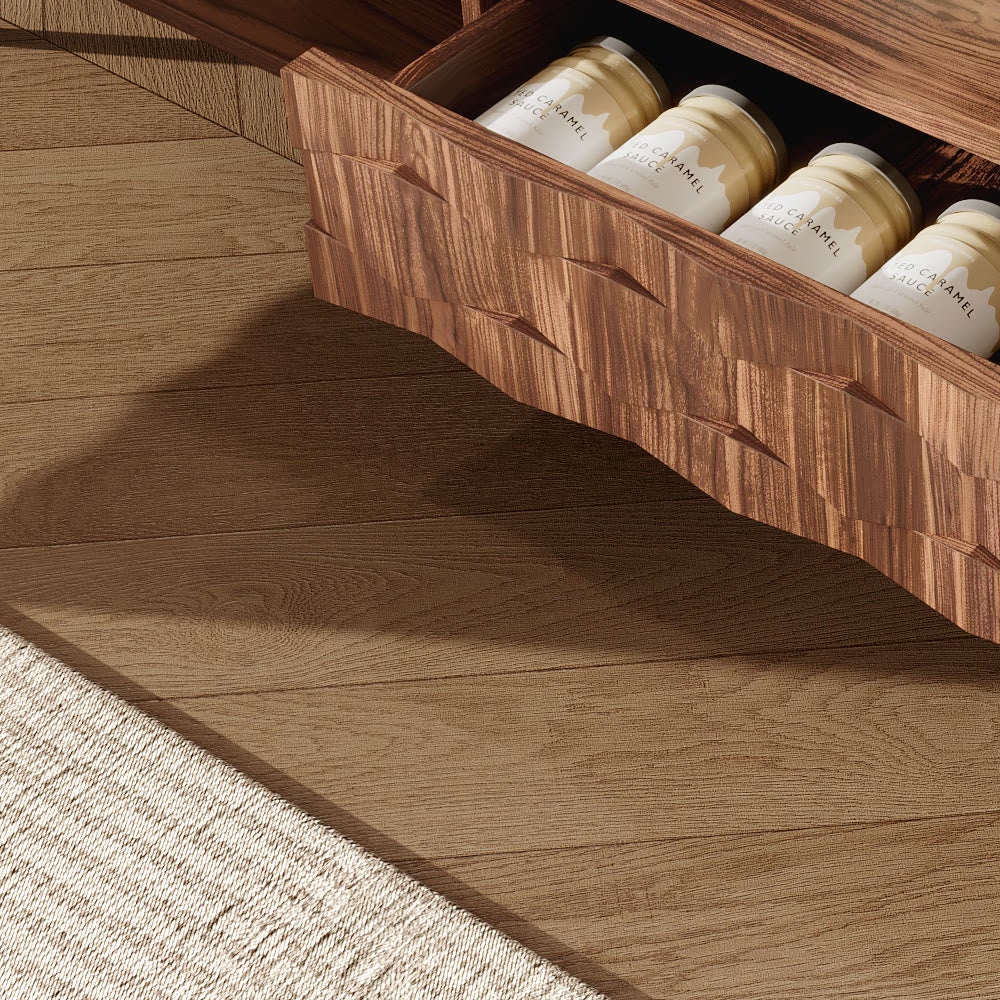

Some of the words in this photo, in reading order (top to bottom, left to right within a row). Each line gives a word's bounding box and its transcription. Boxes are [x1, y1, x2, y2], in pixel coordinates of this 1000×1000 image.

[509, 99, 549, 121] SAUCE
[537, 95, 588, 141] CARAMEL
[623, 151, 665, 173] SAUCE
[651, 147, 704, 194] CARAMEL
[759, 213, 801, 236] SAUCE
[787, 208, 841, 257] CARAMEL
[889, 272, 934, 297] SAUCE
[919, 268, 974, 319] CARAMEL
